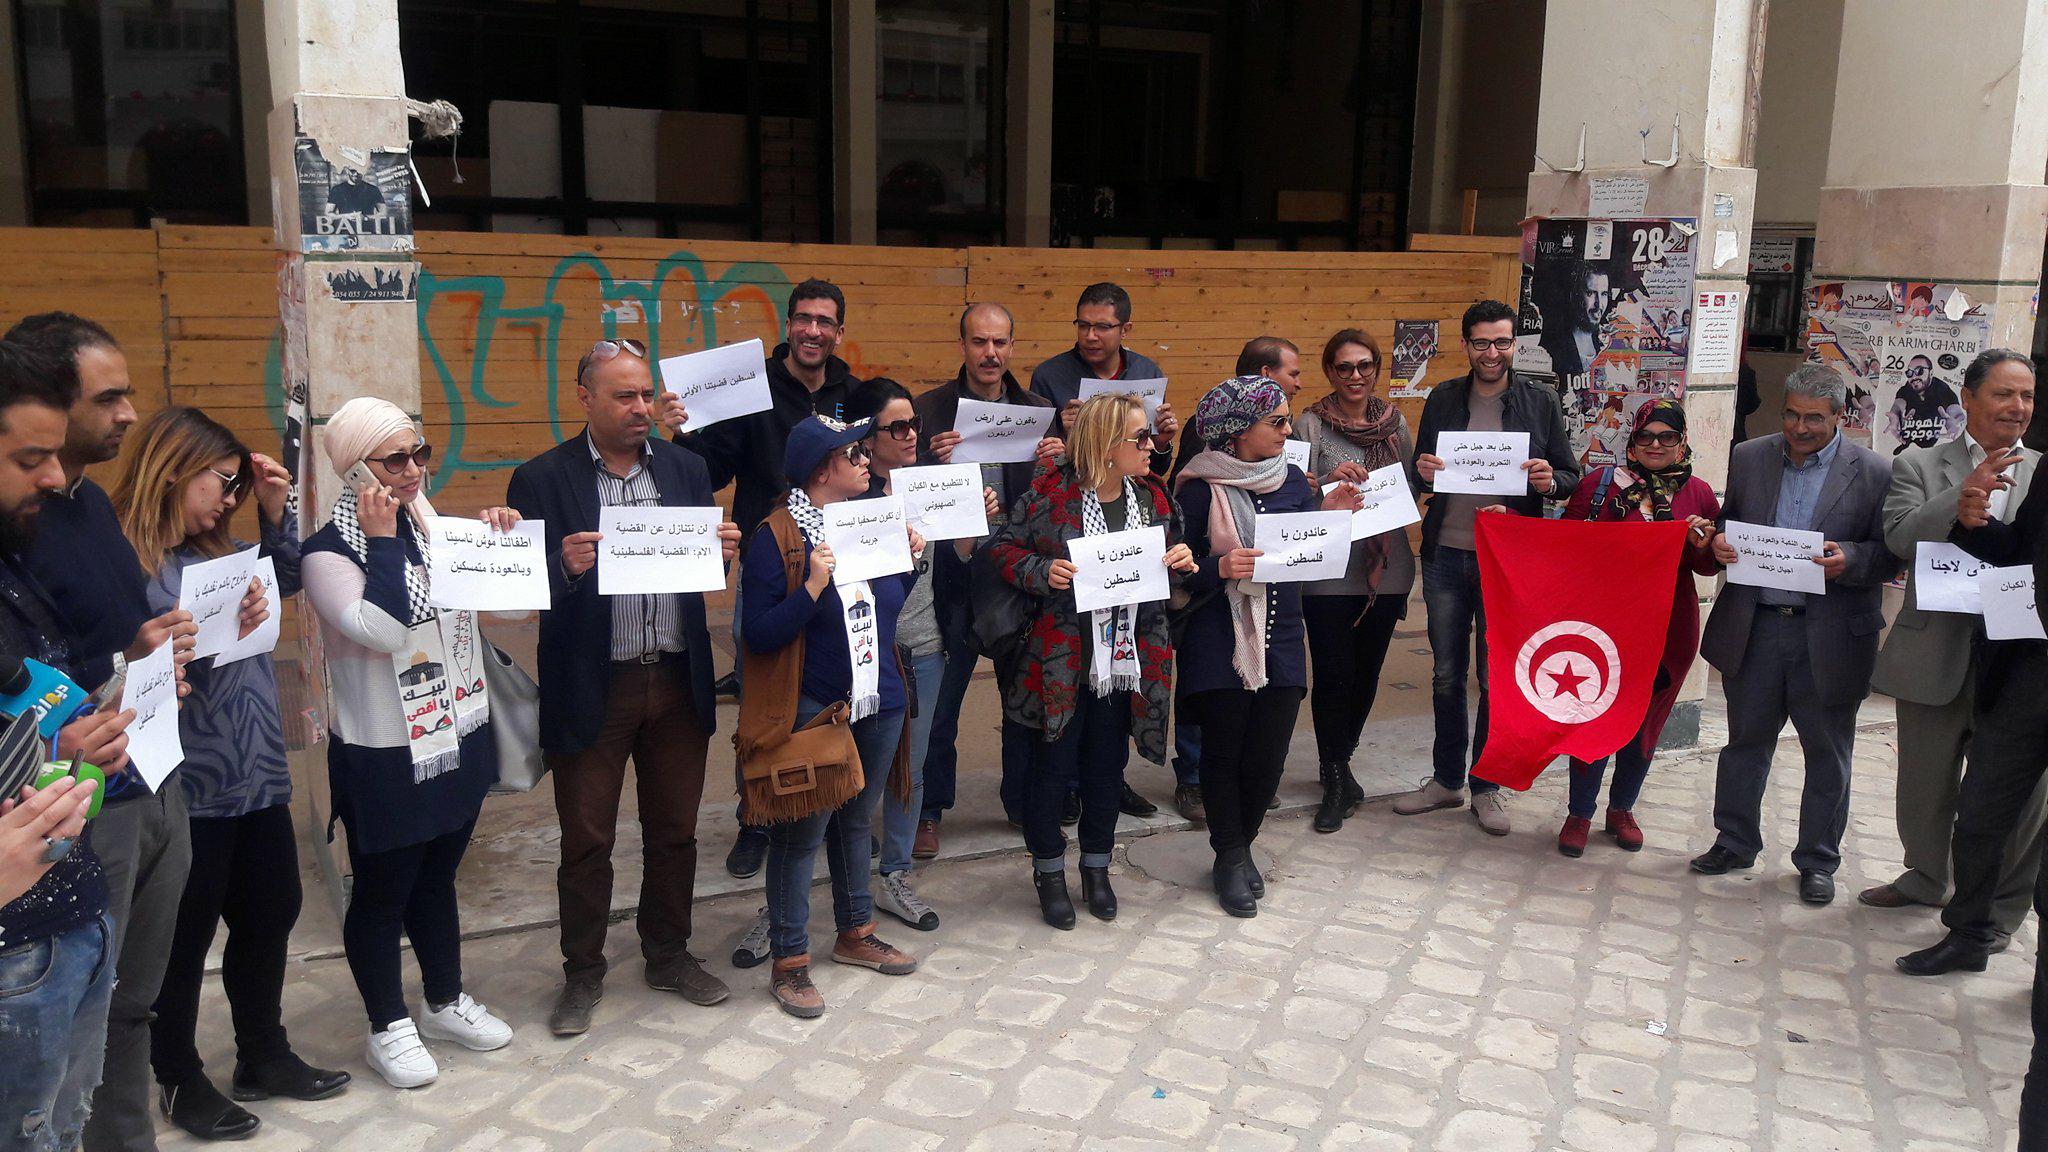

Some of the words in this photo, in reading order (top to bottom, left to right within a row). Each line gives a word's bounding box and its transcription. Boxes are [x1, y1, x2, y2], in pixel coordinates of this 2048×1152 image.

[316, 212, 396, 235] BALTI
[1631, 227, 1665, 263] 28
[1888, 336, 1929, 349] KARIM
[1930, 339, 1976, 353] GHARBI
[1885, 354, 1905, 370] 26
[704, 378, 728, 390] قضيتنا
[730, 371, 756, 386] فلسطين
[681, 384, 702, 399] الأولى
[974, 414, 994, 424] ارض
[996, 416, 1012, 426] على
[1015, 416, 1037, 426] باقون
[1902, 414, 1946, 429] ماهوش
[1903, 428, 1941, 442] موجود
[1454, 444, 1468, 452] حتى
[1470, 442, 1483, 452] جيل
[1486, 444, 1496, 452] بعد
[1498, 443, 1512, 452] جيل
[1462, 458, 1484, 466] والعودة
[1488, 459, 1511, 467] التحرير
[942, 478, 964, 490] للتطبيع
[964, 478, 970, 486] لا
[1470, 474, 1495, 482] فلسطين
[908, 481, 927, 492] الكيان
[930, 482, 940, 492] مع
[1374, 480, 1387, 492] تكون
[924, 498, 956, 512] الصهيوني
[836, 517, 855, 528] ليست
[858, 516, 878, 526] صحفيا
[879, 512, 894, 523] تكون
[616, 522, 646, 535] القضية
[650, 525, 664, 535] عن
[668, 522, 694, 536] نتنازل
[697, 523, 708, 535] لن
[444, 531, 473, 545] ناسينا
[476, 534, 496, 548] موش
[860, 535, 878, 546] جريمة
[1282, 528, 1288, 542] يا
[1757, 536, 1779, 545] والعودة
[500, 536, 532, 548] اطفالنا
[1781, 538, 1798, 546] النكبة
[1800, 542, 1812, 550] بين
[610, 546, 656, 559] الفلسطينية
[660, 546, 690, 558] القضية
[1097, 550, 1106, 563] يا
[1286, 550, 1322, 566] فلسطين
[1757, 550, 1772, 558] ينزف
[1776, 552, 1790, 560] جرحا
[450, 560, 486, 573] متمسكين
[490, 562, 532, 576] وبالعودة
[1758, 564, 1775, 572] تزحف
[1776, 566, 1794, 574] اجيال
[1104, 570, 1140, 589] فلسطين
[2000, 580, 2026, 592] الكيان
[852, 619, 872, 634] لبيك
[866, 635, 872, 647] يا
[406, 698, 438, 722] أقصى
[440, 698, 450, 712] يا
